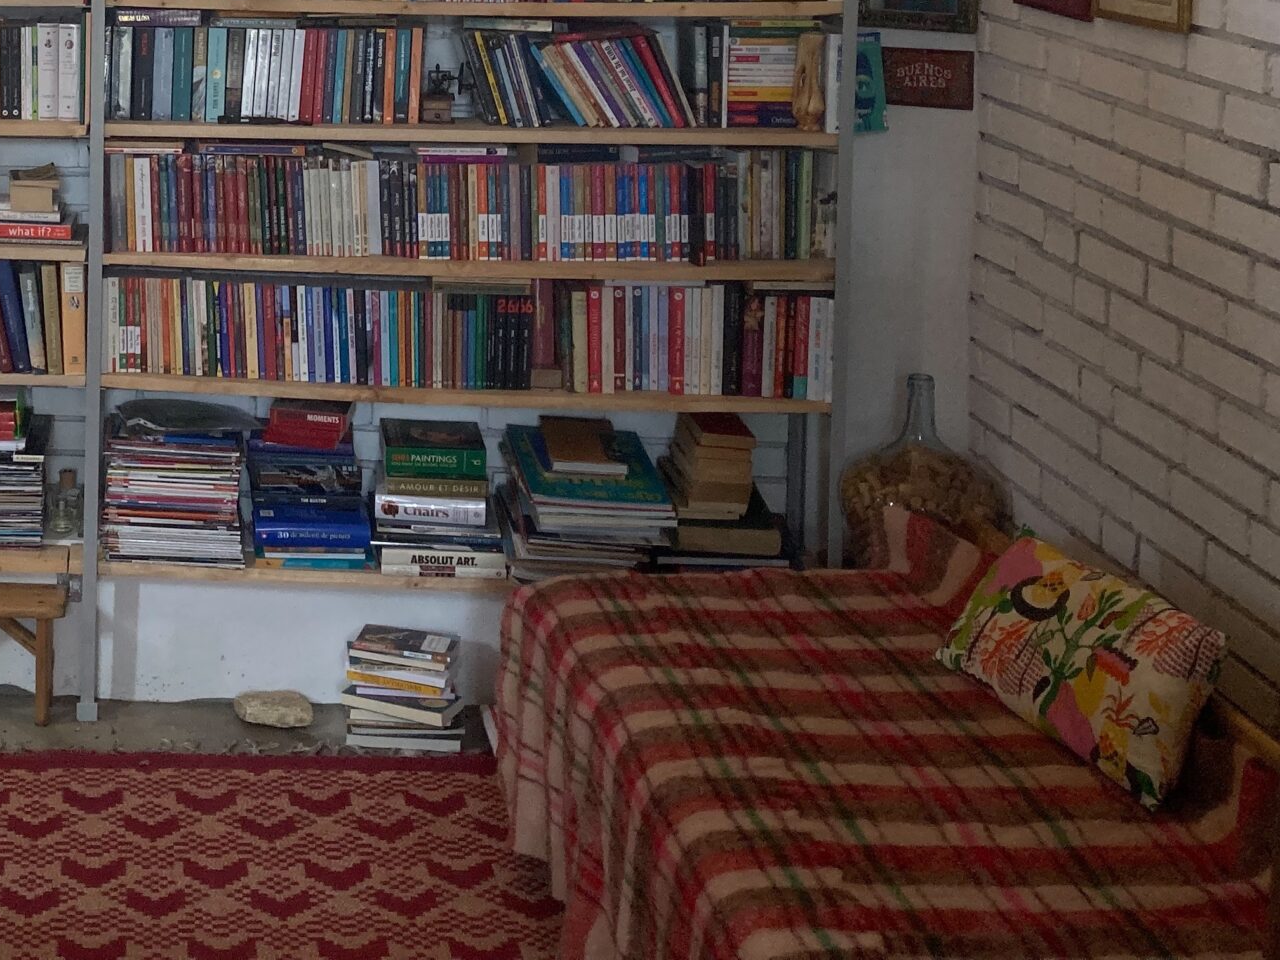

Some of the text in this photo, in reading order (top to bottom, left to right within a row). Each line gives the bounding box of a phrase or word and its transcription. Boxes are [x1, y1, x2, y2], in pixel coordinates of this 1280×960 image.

[896, 62, 953, 80] BUENOS
[903, 75, 947, 89] AIRES
[8, 226, 52, 238] what if?
[306, 414, 341, 425] MOMENTS
[411, 453, 458, 464] PAINTINGS
[399, 483, 435, 492] AMOUR
[439, 484, 449, 492] ET
[404, 502, 450, 519] Chairs
[277, 531, 289, 539] 30
[410, 554, 479, 568] ABSOLUT ART.
